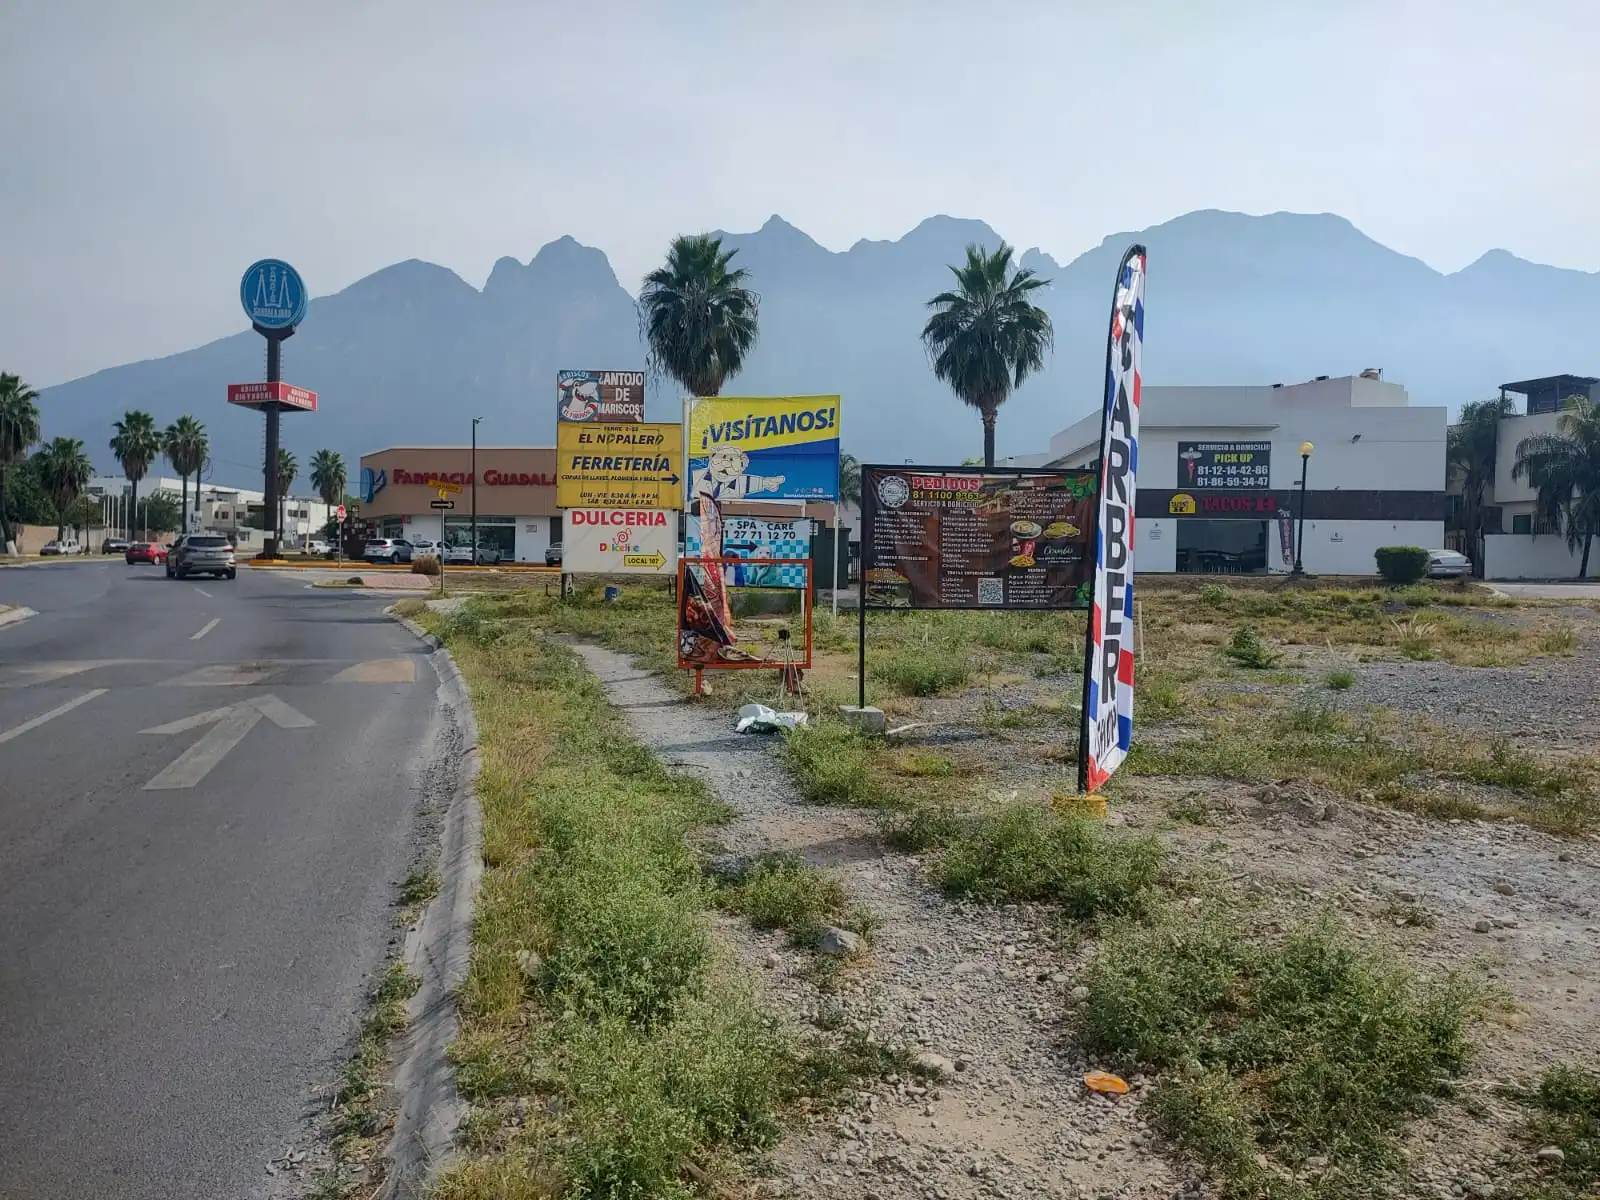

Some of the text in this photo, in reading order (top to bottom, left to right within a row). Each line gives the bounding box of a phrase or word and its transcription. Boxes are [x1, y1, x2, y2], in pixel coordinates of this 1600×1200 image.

[615, 388, 630, 402] DE
[701, 407, 836, 449] ¡VISÍTANOS!
[578, 434, 664, 445] EL NOPALERO
[571, 453, 670, 472] FERRETERÍA
[1214, 454, 1254, 463] PICK UP
[912, 477, 981, 491] PEDIDOS
[912, 490, 980, 500] 81 1100 9363
[1204, 496, 1250, 511] TACOS
[571, 511, 667, 526] DULCERIA
[737, 520, 757, 530] SPA
[767, 522, 794, 531] CARE
[734, 531, 747, 539] 27
[750, 531, 762, 539] 71
[768, 531, 780, 540] 12
[783, 531, 796, 540] 70
